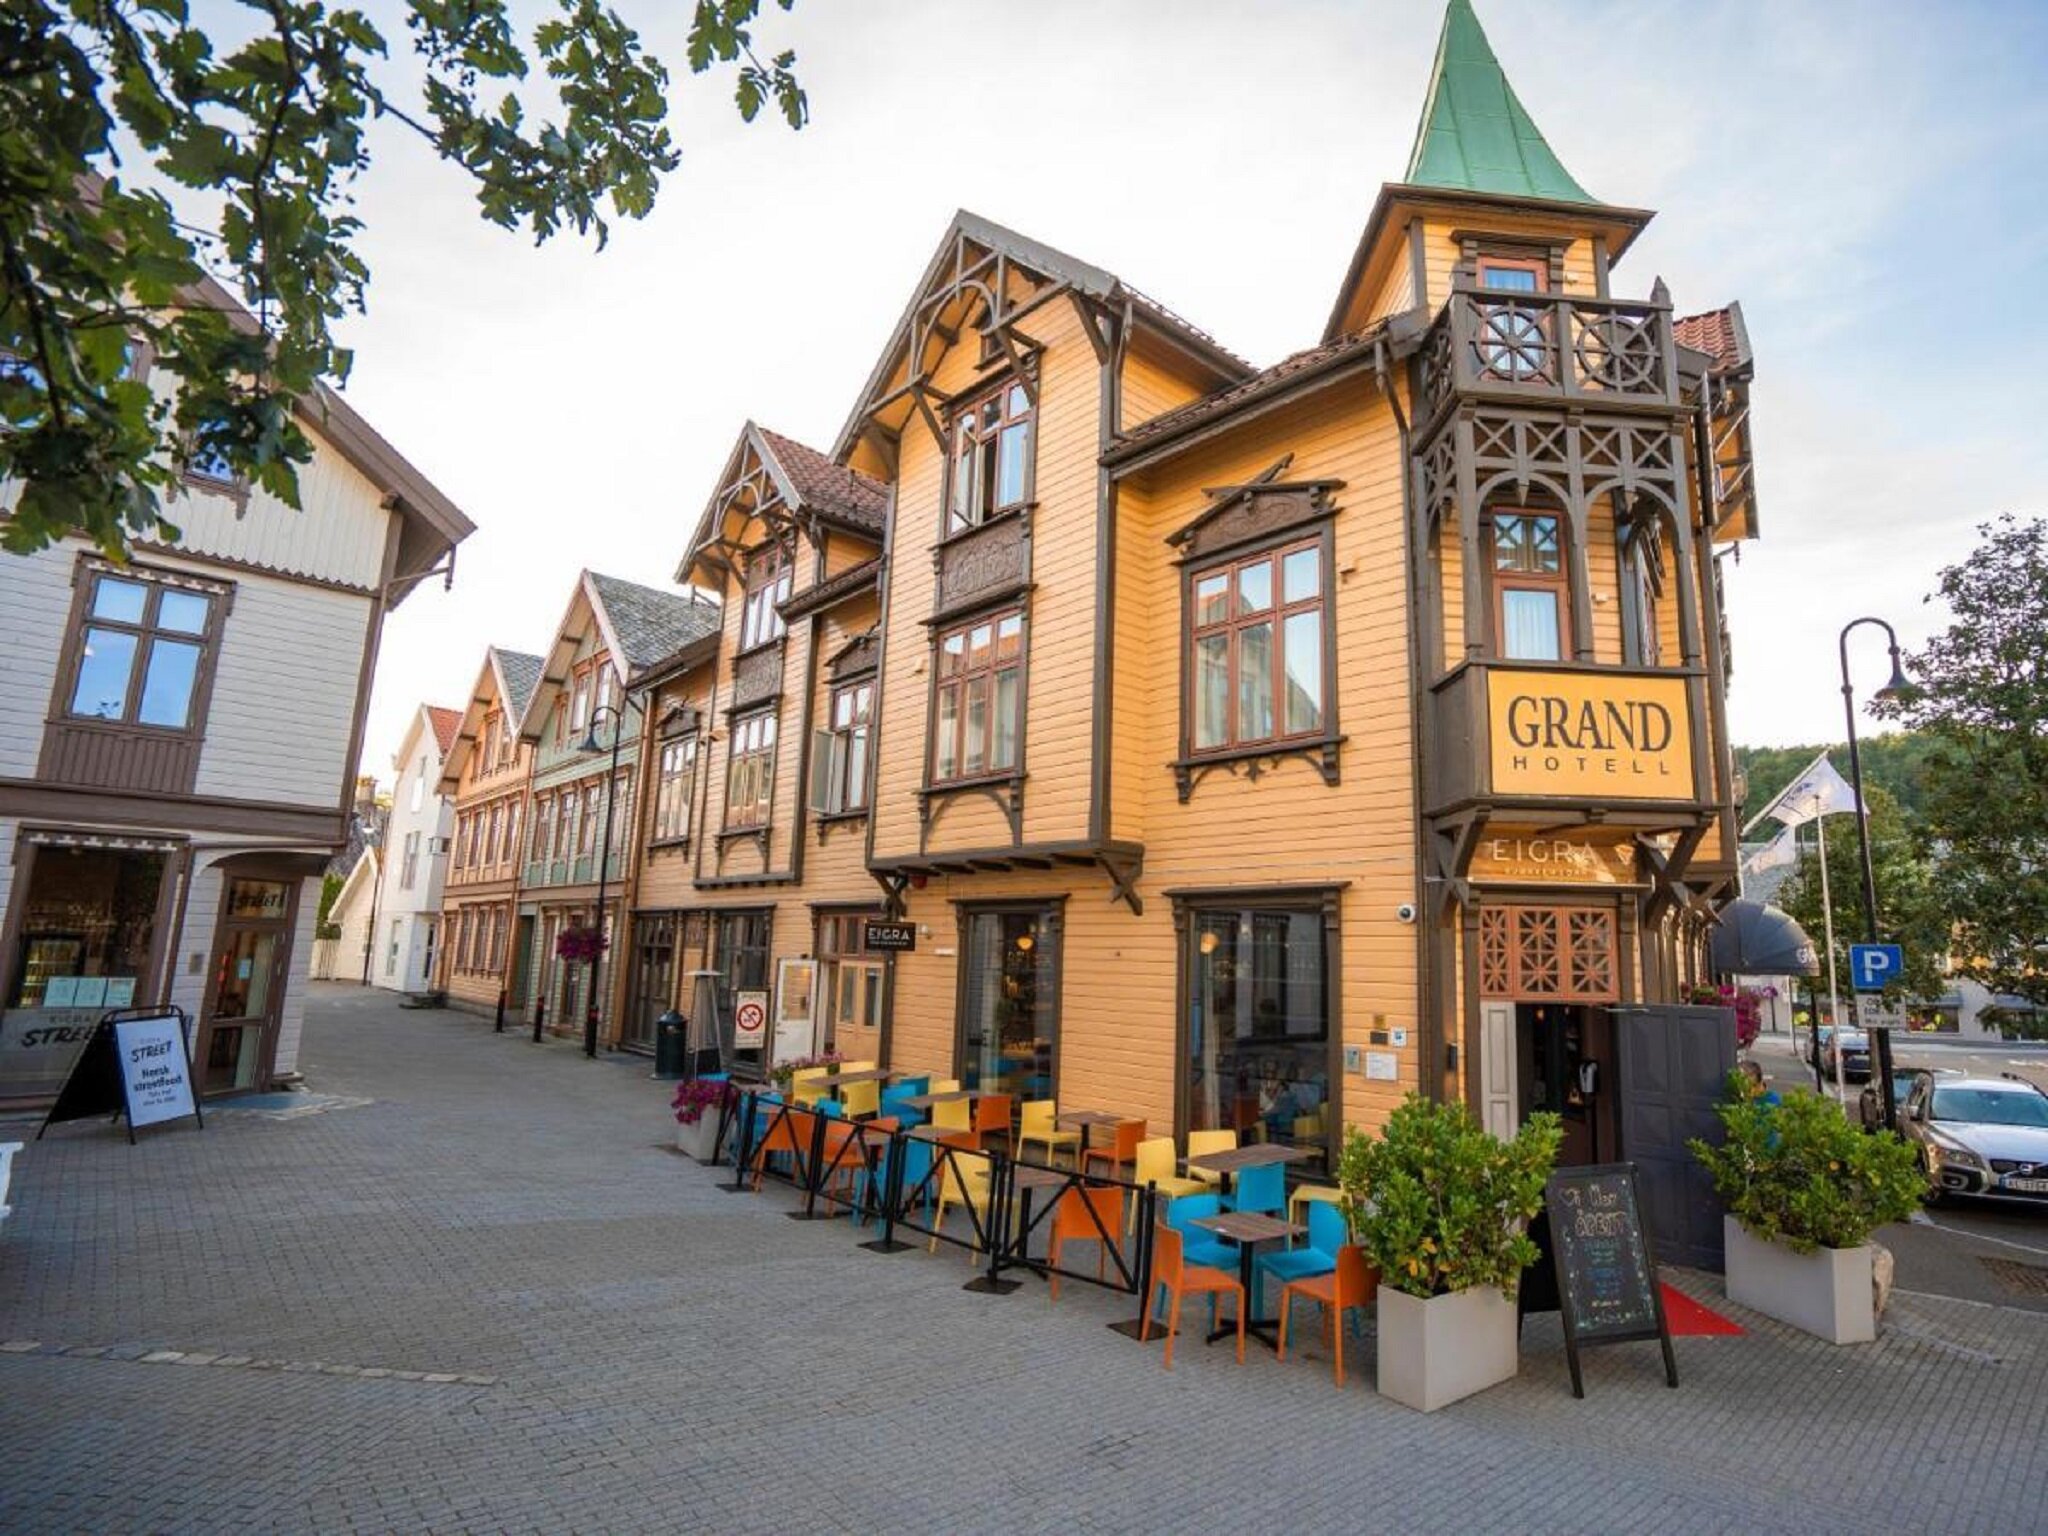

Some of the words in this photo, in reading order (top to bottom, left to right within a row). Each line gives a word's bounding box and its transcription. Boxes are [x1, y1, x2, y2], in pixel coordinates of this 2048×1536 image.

[1508, 695, 1672, 752] GRAND
[1512, 755, 1670, 775] HOTELL
[1491, 838, 1599, 864] EIGRA
[868, 927, 910, 940] EIGRA
[1863, 950, 1890, 982] P
[21, 1025, 96, 1047] STREE
[131, 1040, 172, 1063] STREET
